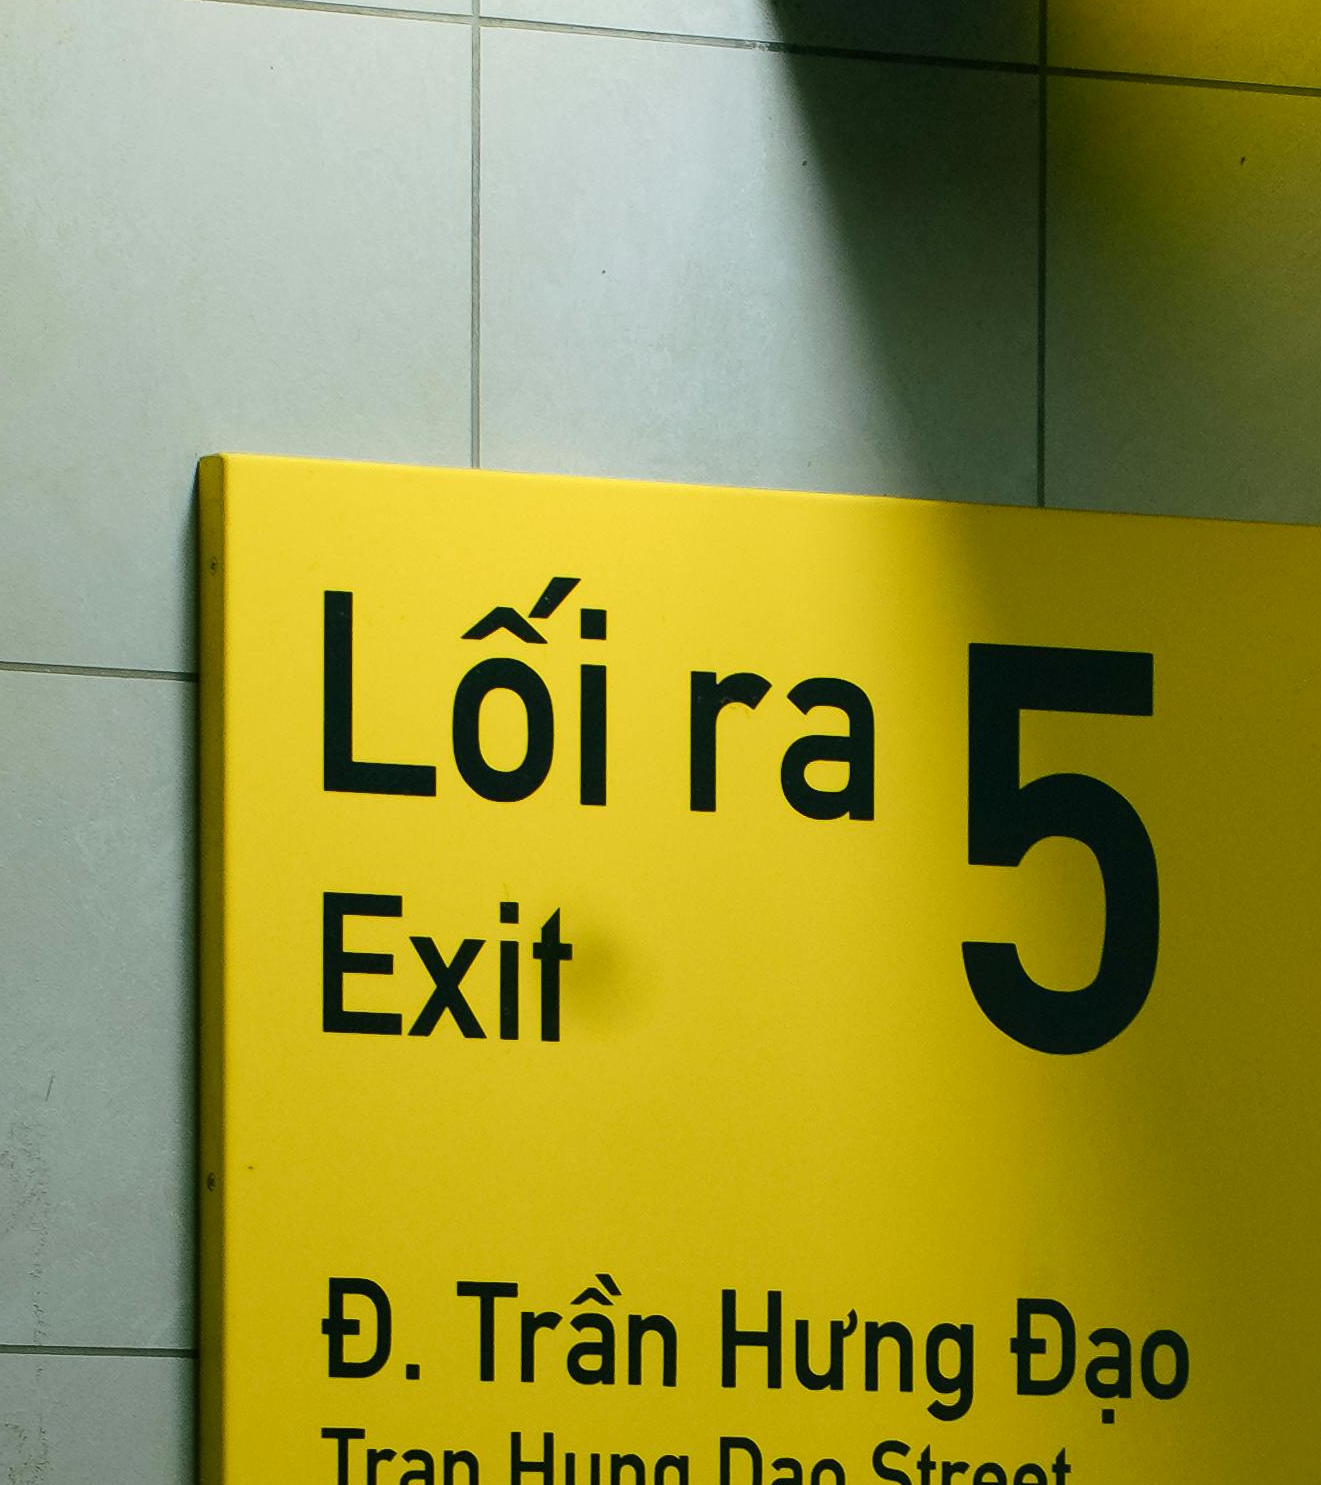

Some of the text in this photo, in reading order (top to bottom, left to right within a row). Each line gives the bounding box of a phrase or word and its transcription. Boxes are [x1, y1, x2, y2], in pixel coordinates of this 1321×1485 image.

[323, 577, 1160, 1055] Lối ra 5
[323, 892, 573, 1042] Exit
[321, 1273, 1191, 1424] Đ. Trần Hưng Đạo
